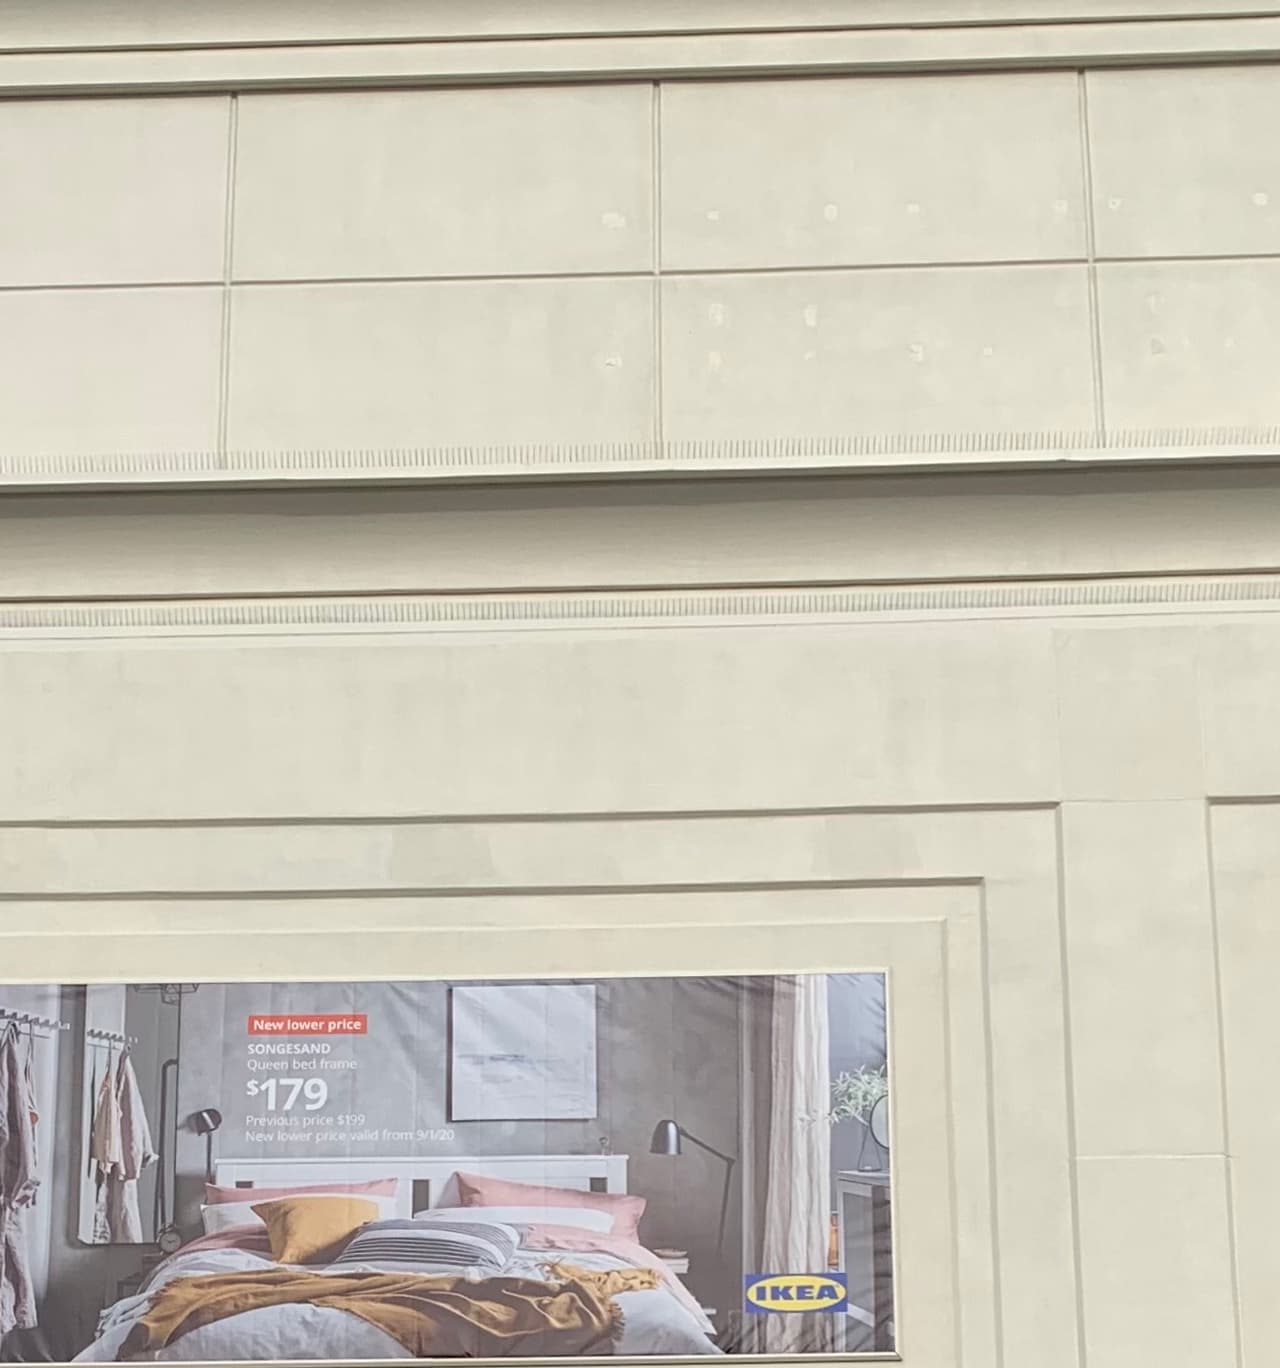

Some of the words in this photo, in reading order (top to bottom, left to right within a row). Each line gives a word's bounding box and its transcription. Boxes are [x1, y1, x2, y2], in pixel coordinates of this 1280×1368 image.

[253, 1019, 284, 1031] New
[287, 1019, 325, 1030] lower
[327, 1018, 362, 1033] price
[247, 1043, 331, 1055] SONGESAND
[247, 1058, 289, 1072] Queen
[292, 1058, 317, 1070] bed
[320, 1058, 358, 1070] frame
[246, 1077, 329, 1112] $179
[245, 1114, 299, 1127] Previous
[303, 1115, 333, 1128] price
[336, 1114, 366, 1125] $199
[245, 1131, 273, 1142] New
[277, 1131, 313, 1142] lower
[315, 1131, 346, 1143] price
[350, 1130, 377, 1141] valid
[381, 1129, 413, 1141] from
[416, 1129, 455, 1142] 9/1/20
[756, 1285, 839, 1301] IKEA
